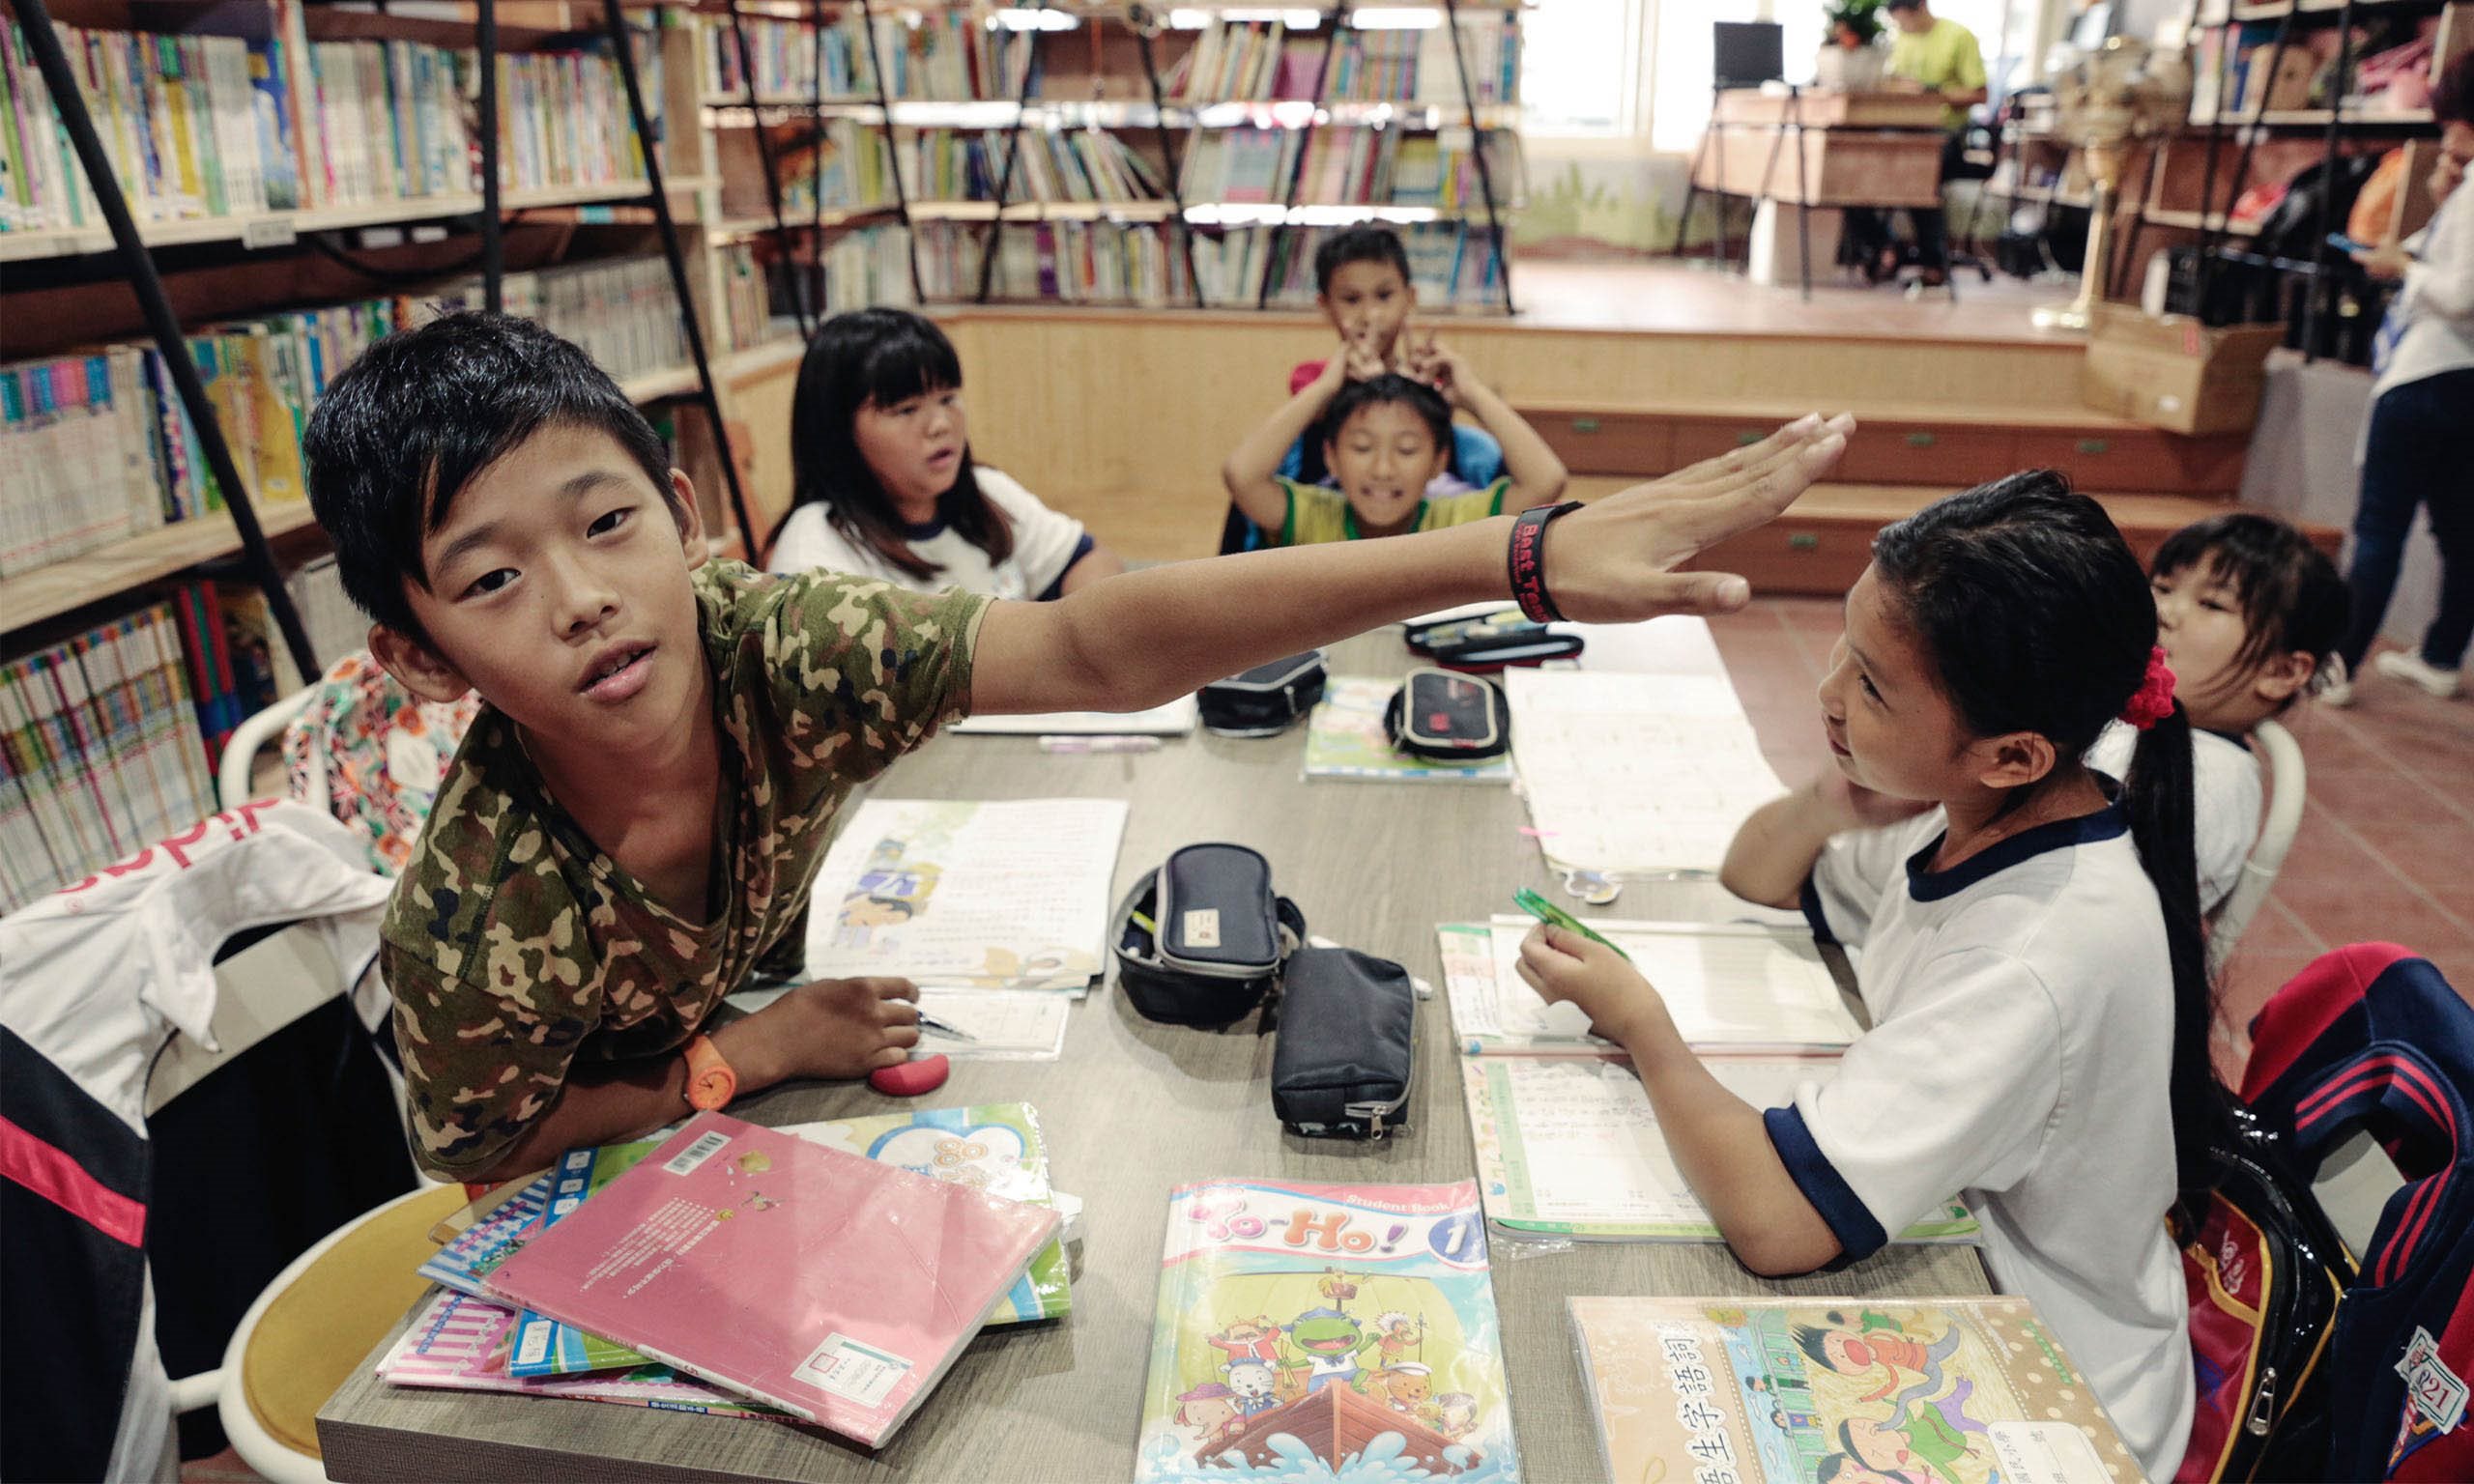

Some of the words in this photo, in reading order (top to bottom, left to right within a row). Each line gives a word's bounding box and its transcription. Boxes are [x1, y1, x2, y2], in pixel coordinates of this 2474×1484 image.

[1346, 1194, 1408, 1213] Student
[1409, 1201, 1450, 1213] Book
[1188, 1199, 1408, 1253] Yo-Ho!
[1443, 1220, 1469, 1255] 1
